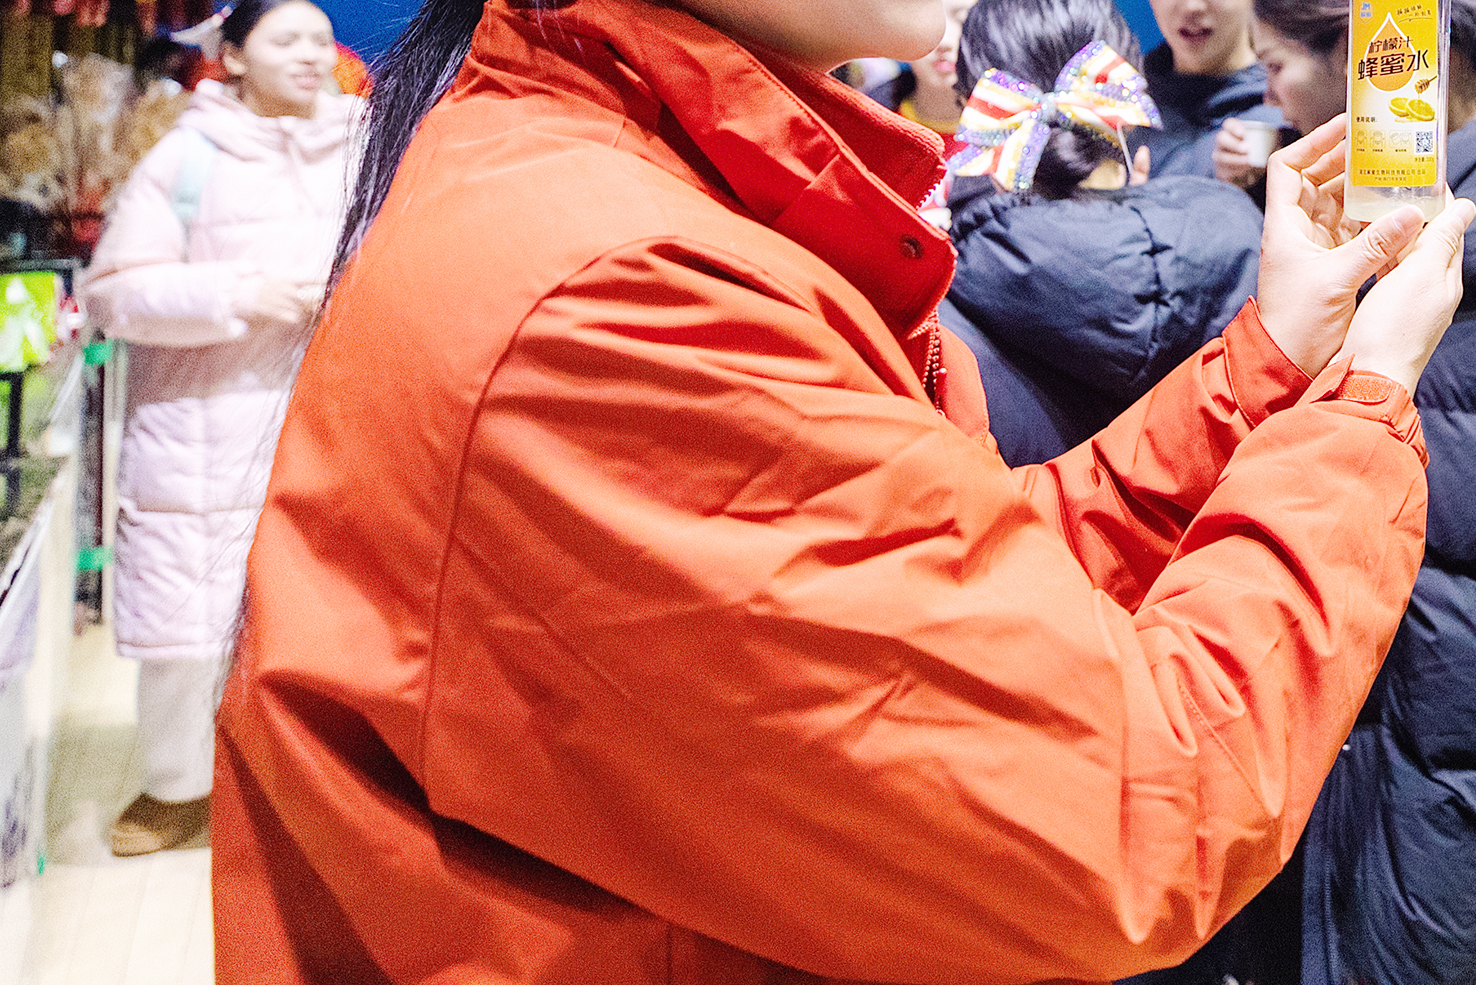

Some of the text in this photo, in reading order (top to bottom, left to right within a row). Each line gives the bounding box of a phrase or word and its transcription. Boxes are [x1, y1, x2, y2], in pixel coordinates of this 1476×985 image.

[1368, 36, 1414, 54] 柠檬汁
[1357, 49, 1430, 81] 蜂蜜水
